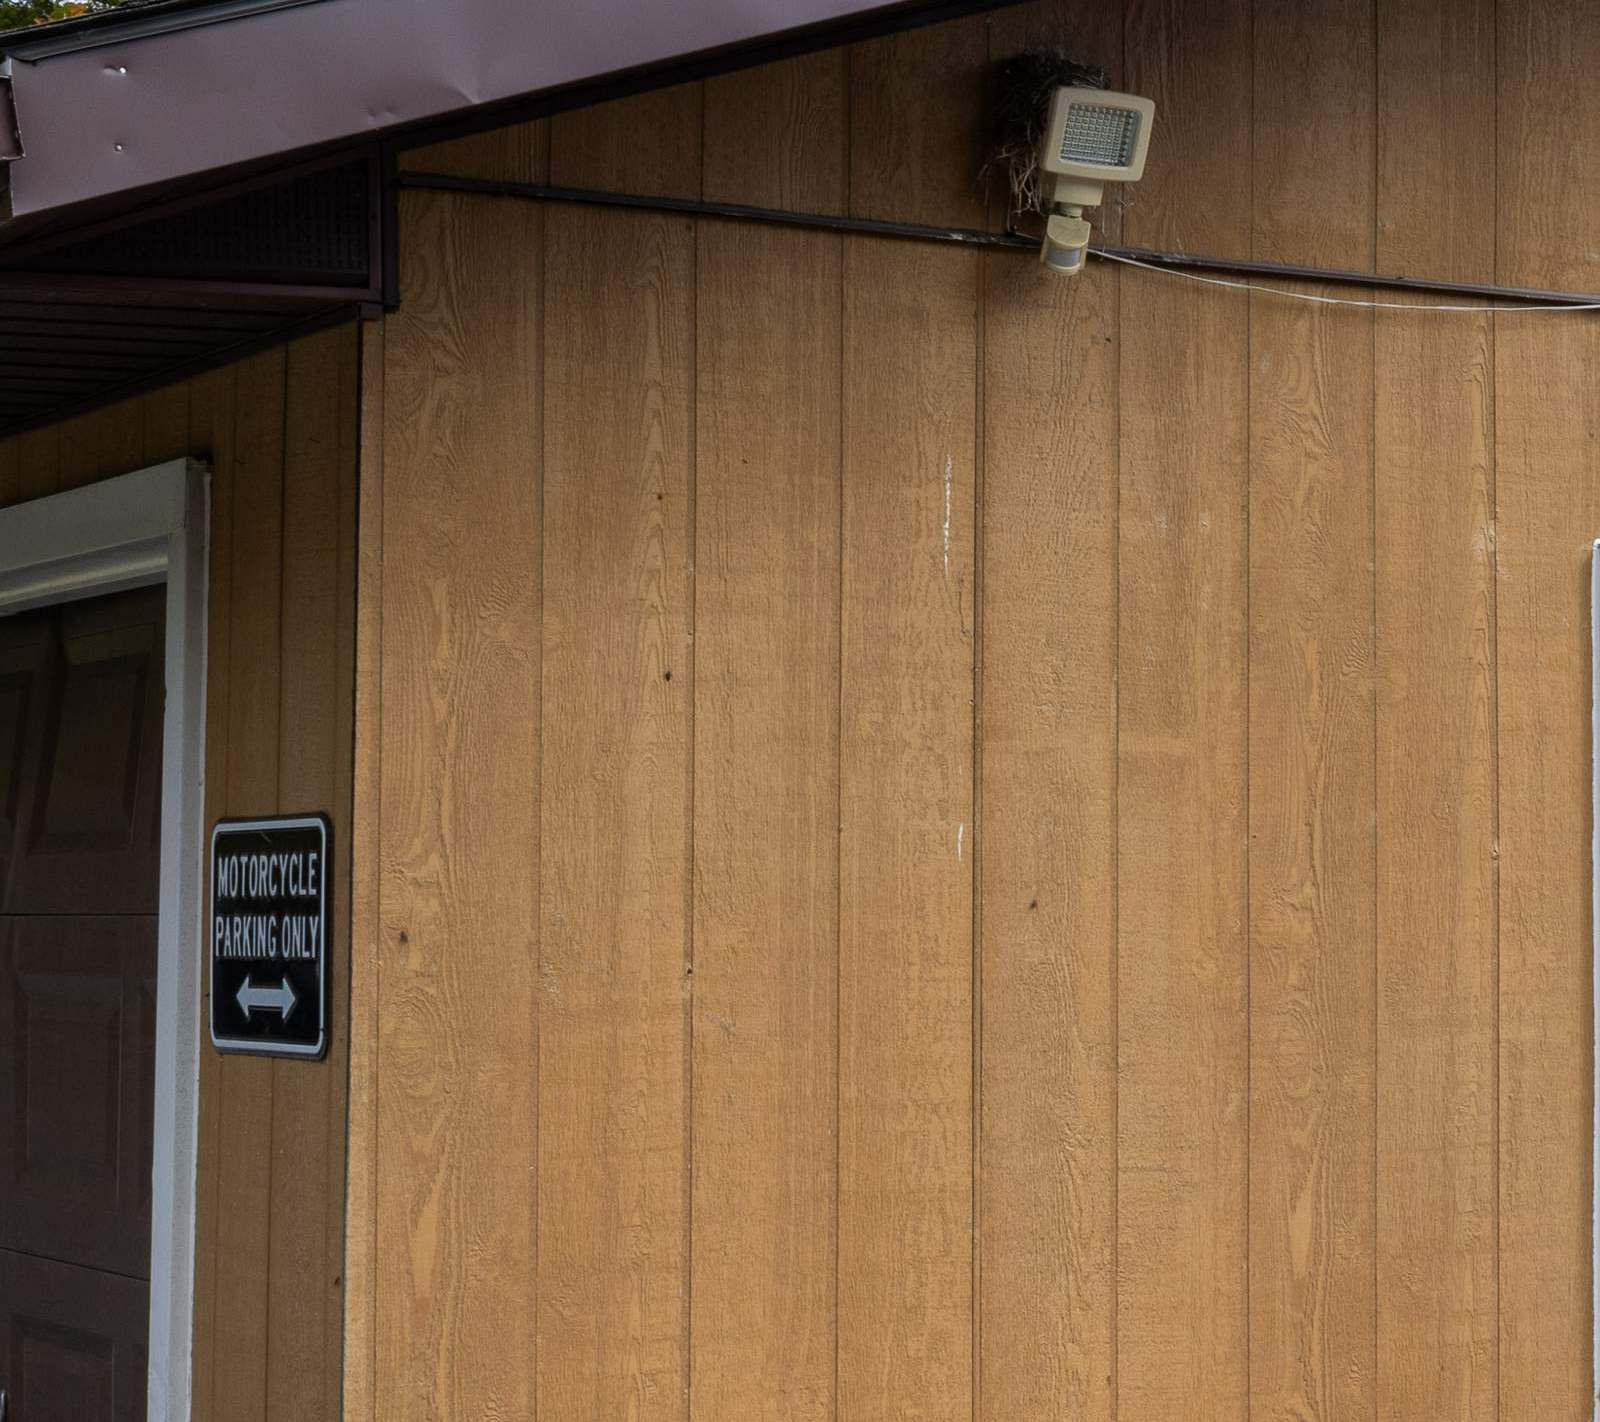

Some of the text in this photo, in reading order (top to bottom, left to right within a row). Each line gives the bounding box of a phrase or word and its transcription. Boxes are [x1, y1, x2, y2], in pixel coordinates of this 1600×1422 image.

[217, 852, 318, 898] MOTORCYCLE
[215, 915, 319, 958] PARKING ONLY
